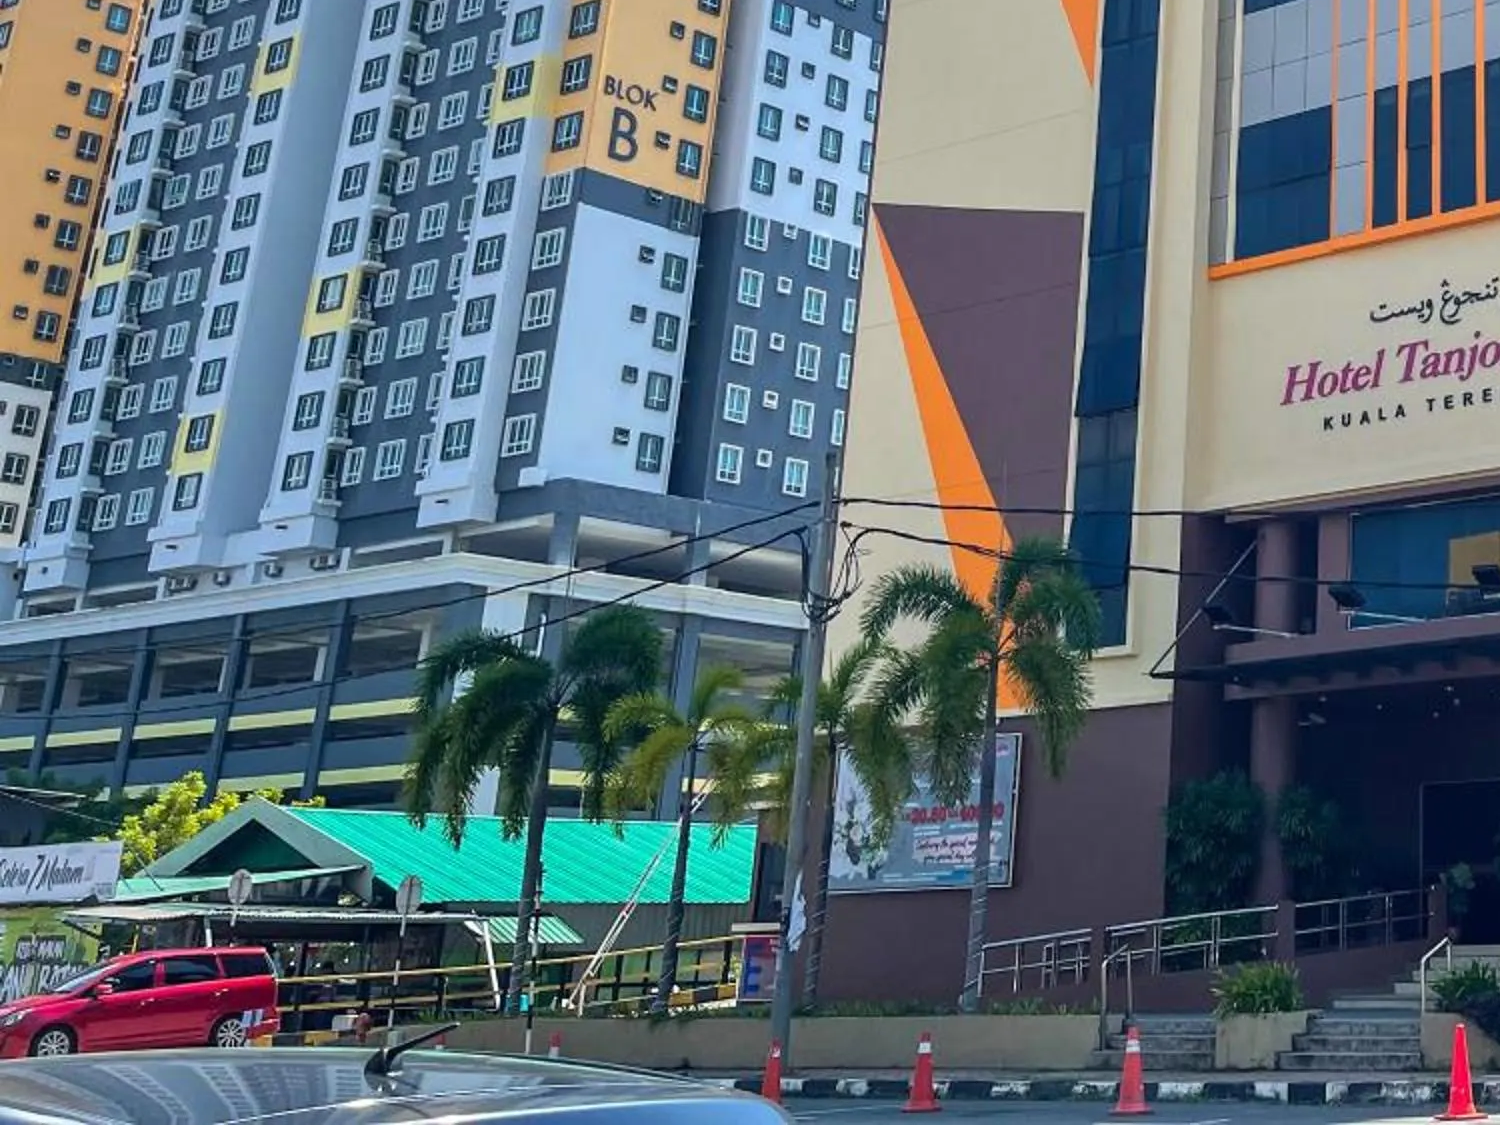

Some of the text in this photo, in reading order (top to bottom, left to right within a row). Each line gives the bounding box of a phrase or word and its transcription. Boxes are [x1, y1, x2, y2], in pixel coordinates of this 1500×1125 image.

[604, 74, 659, 111] BLOK
[607, 106, 638, 162] B
[1279, 348, 1386, 406] Hotel
[1322, 402, 1407, 431] KUALA
